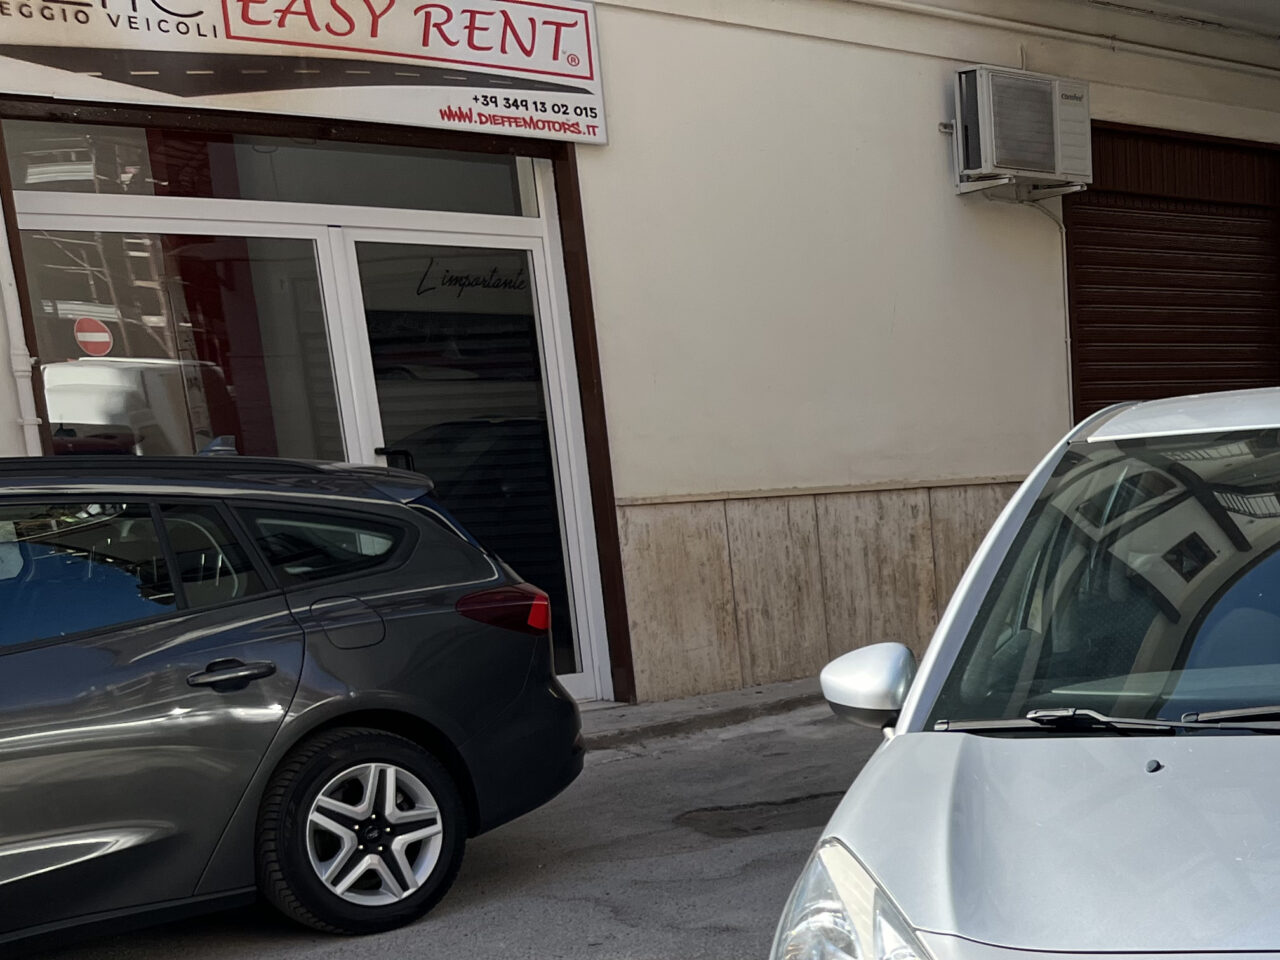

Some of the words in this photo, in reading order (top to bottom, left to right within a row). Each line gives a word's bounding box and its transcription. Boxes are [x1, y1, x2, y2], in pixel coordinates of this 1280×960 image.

[106, 13, 218, 38] VEICOLI
[239, 0, 396, 38] EASY
[414, 3, 578, 61] RENT
[473, 95, 498, 107] +39
[503, 98, 528, 111] 349
[533, 101, 547, 113] 13
[551, 103, 569, 115] 02
[574, 106, 598, 118] 015
